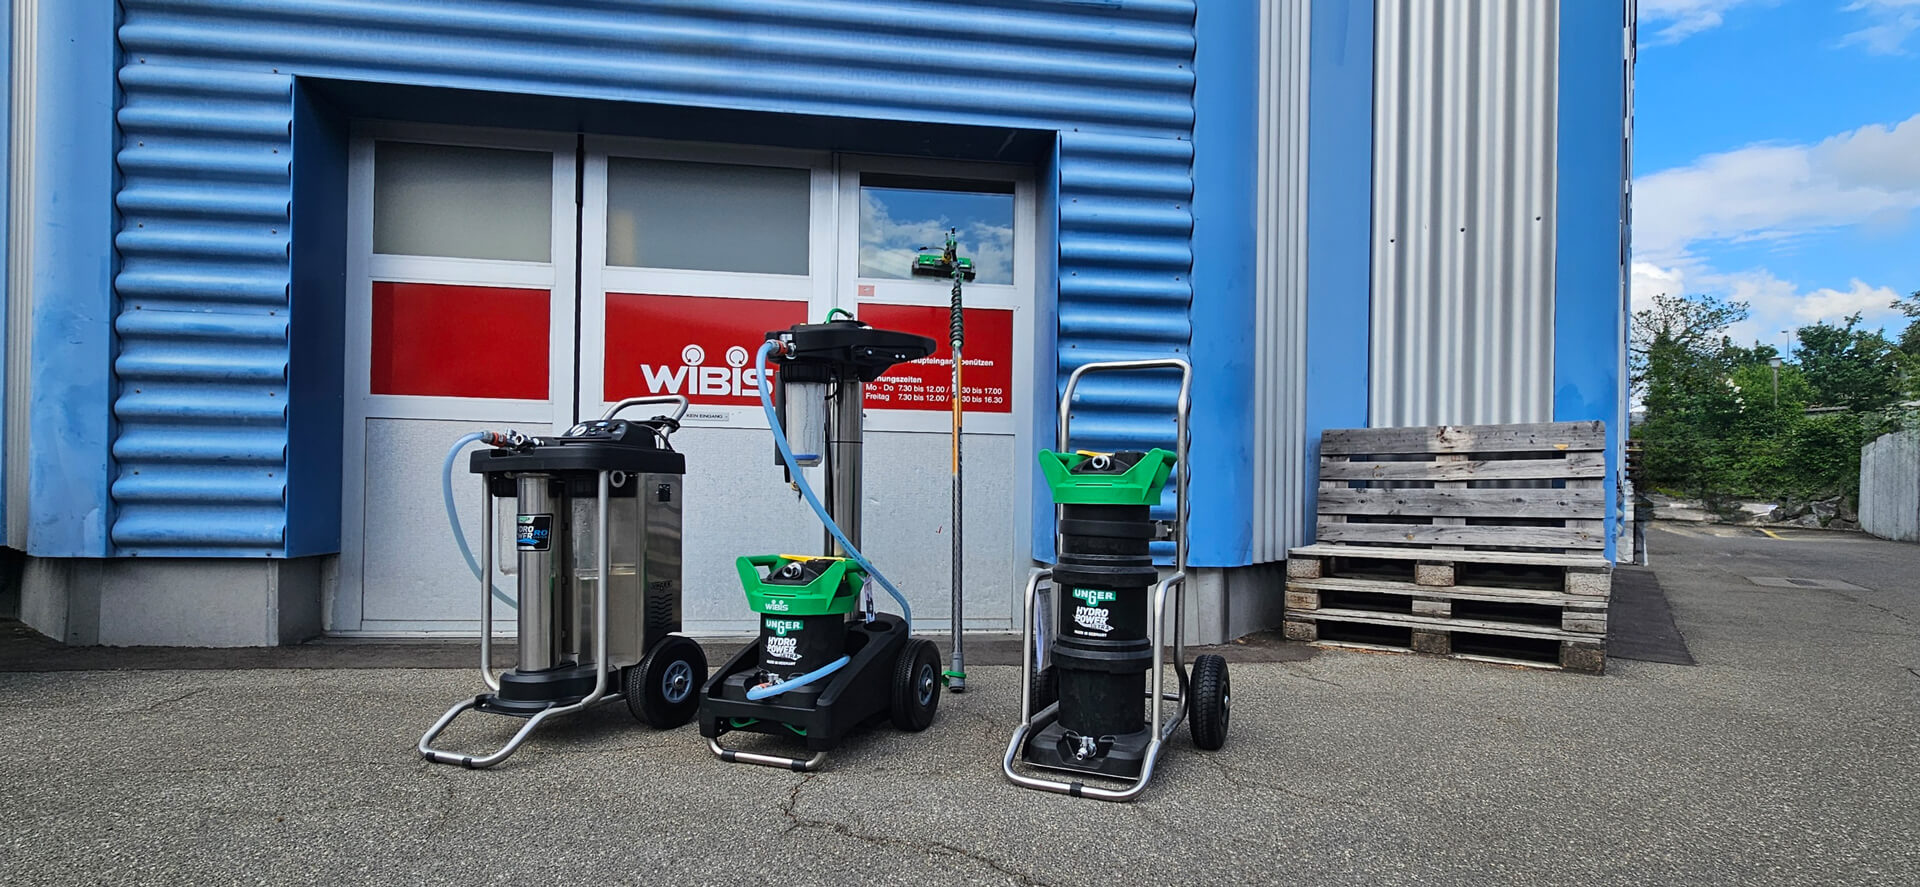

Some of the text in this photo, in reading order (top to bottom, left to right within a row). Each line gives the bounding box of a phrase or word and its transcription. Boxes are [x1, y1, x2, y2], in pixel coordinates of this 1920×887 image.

[865, 393, 890, 401] Freitag
[1074, 588, 1113, 605] UNGER
[1076, 605, 1109, 618] HYDRO
[1075, 614, 1109, 625] POWER
[766, 619, 801, 635] UNGER
[768, 636, 797, 646] HYDRO
[767, 644, 797, 655] POWER
